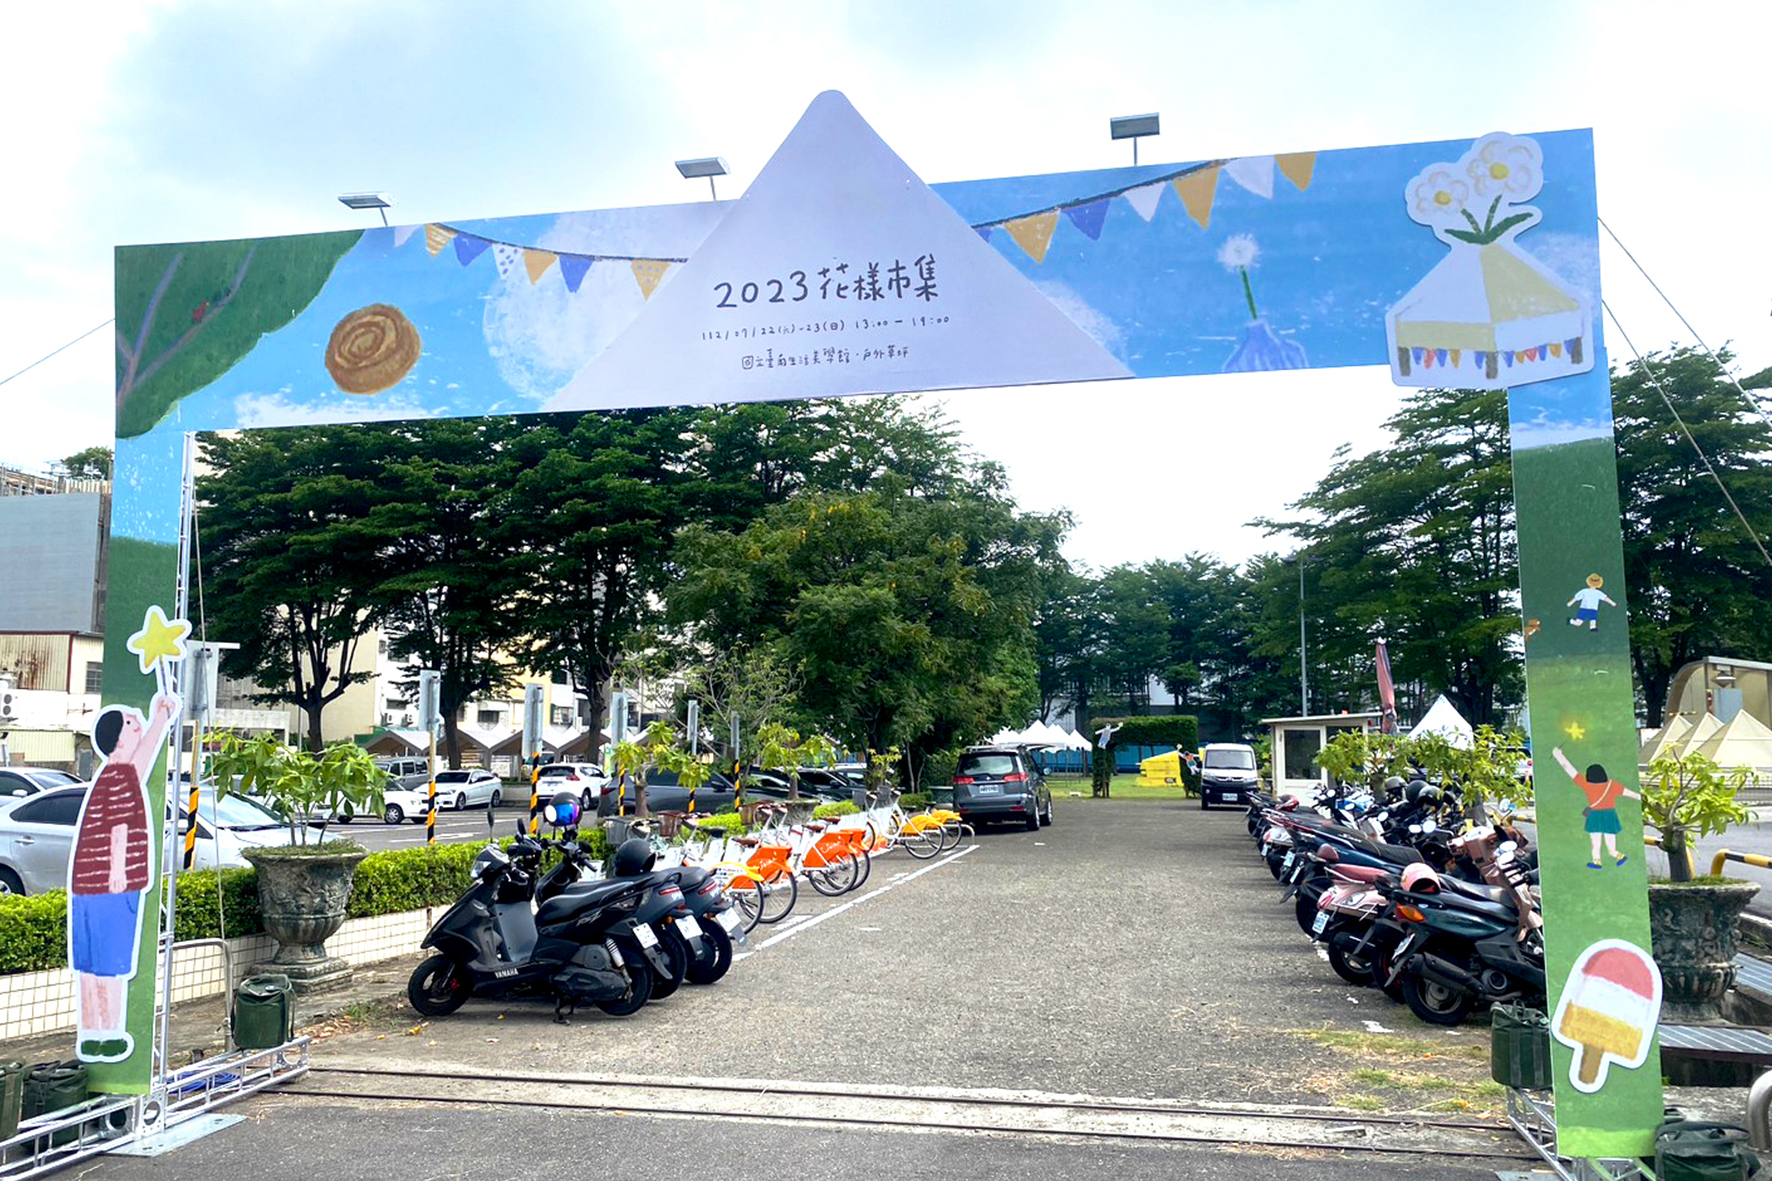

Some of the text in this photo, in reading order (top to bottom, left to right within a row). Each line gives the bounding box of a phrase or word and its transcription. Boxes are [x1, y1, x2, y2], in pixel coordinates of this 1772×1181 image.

[713, 253, 938, 308] 2023花樣市集
[855, 318, 889, 330] 13:00
[911, 315, 950, 327] 19:00
[494, 967, 519, 979] YAMAHA
